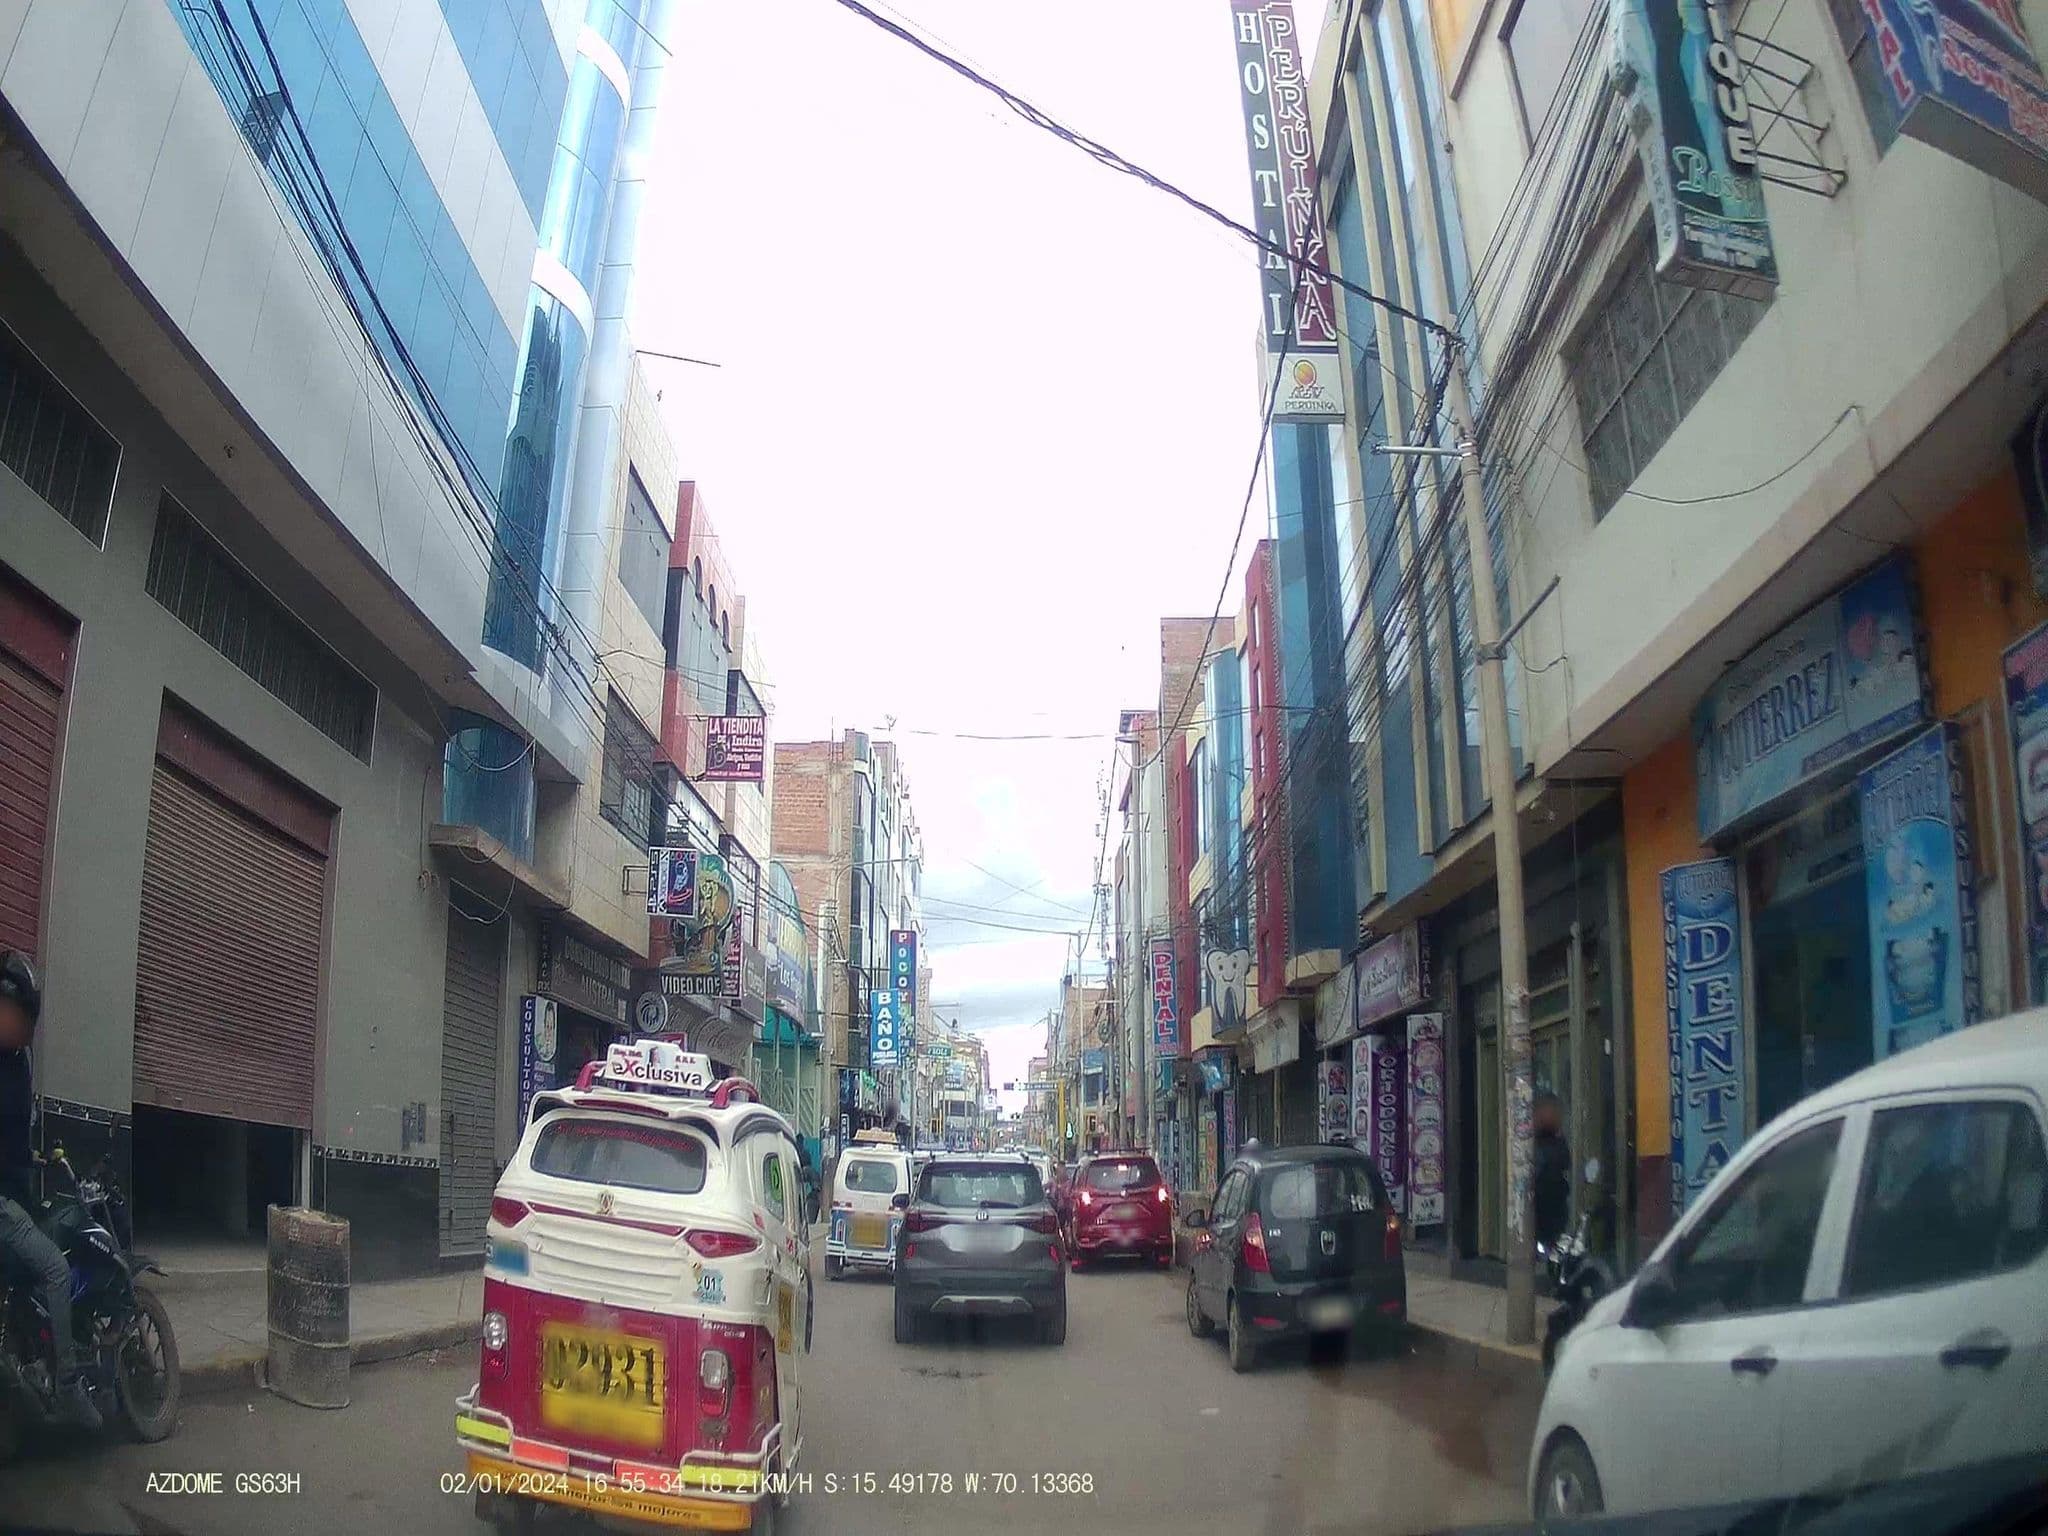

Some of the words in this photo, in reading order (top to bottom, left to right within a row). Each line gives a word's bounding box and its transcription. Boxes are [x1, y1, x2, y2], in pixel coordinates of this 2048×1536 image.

[1707, 0, 1758, 166] IQUE
[1236, 11, 1293, 336] HOSTAL
[709, 717, 721, 734] LA
[722, 717, 763, 735] TIENDITA
[661, 975, 694, 994] VIDEO
[877, 992, 893, 1050] BAÑO
[1153, 953, 1175, 1036] DENTAL
[1665, 900, 1683, 1144] CONSULTORIO
[611, 1058, 703, 1086] eXclusiva
[1378, 1056, 1398, 1187] ORTODONCIA
